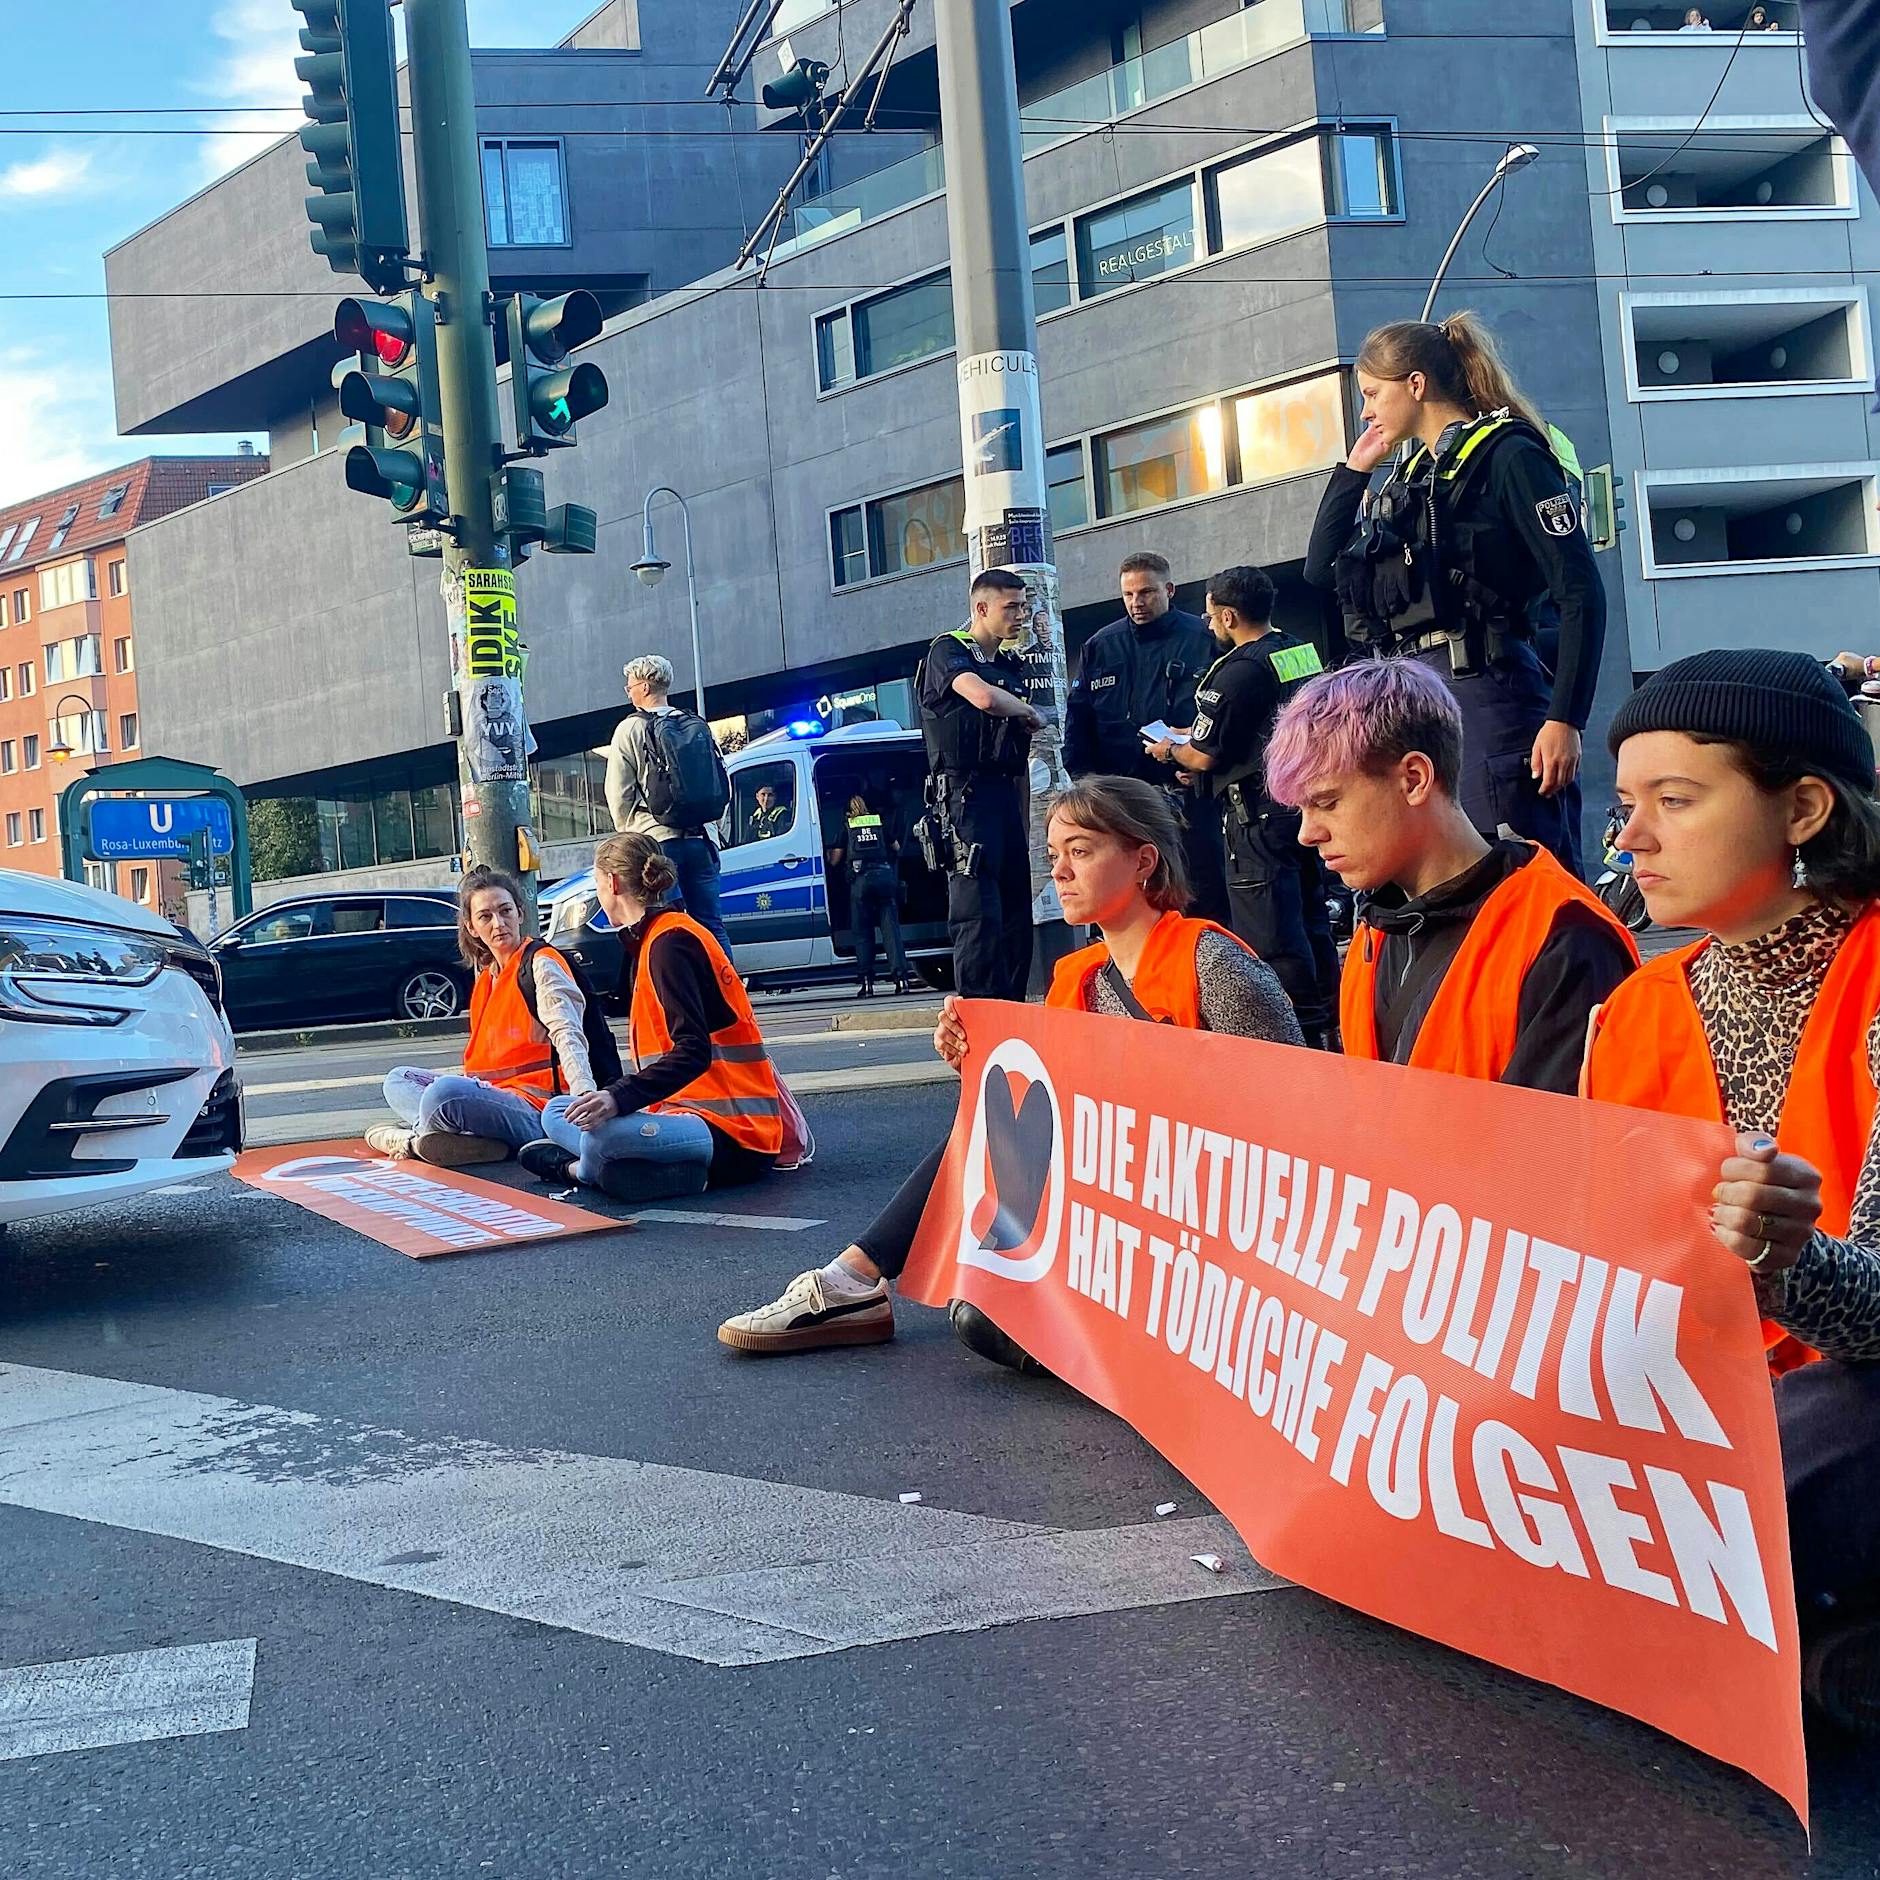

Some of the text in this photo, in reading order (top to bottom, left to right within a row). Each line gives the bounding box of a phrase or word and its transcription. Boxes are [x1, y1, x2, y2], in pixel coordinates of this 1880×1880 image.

[1090, 675, 1116, 691] POLIZEI
[833, 692, 877, 710] SquareOne
[480, 722, 516, 736] YVY
[149, 803, 174, 834] U
[408, 1188, 566, 1238] GENERATIO
[1072, 1093, 1734, 1450] DIE AKTUELLE POLITIK
[1067, 1200, 1779, 1655] HAT TÖDLICHE FOLGEN
